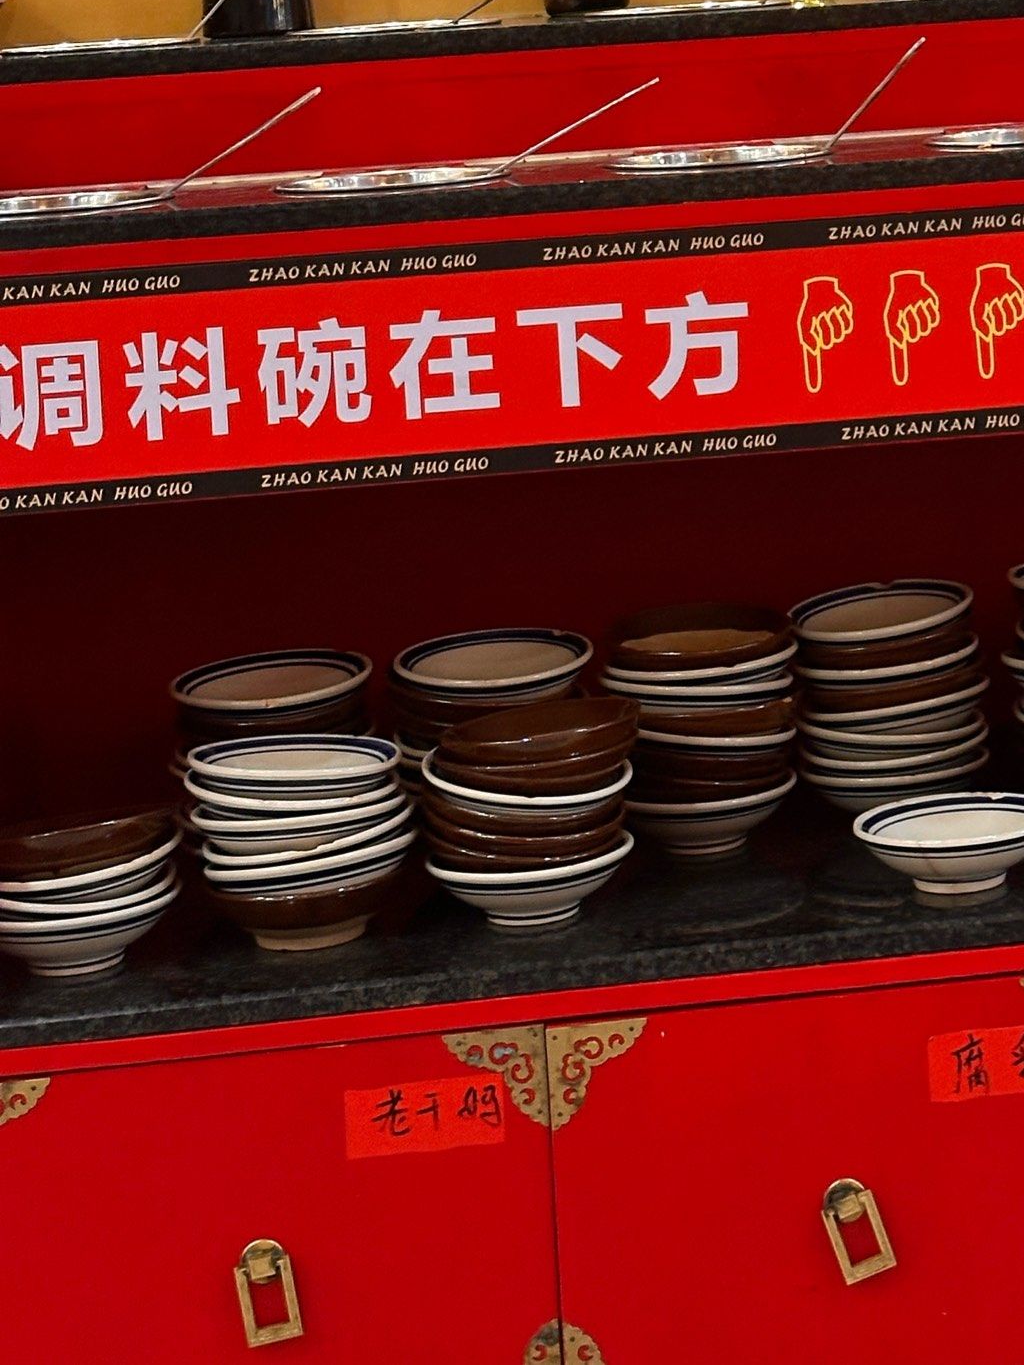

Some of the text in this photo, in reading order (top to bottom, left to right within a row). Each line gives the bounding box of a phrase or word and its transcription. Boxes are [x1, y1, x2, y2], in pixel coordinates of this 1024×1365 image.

[828, 224, 877, 240] ZHAO
[881, 221, 919, 236] KAN
[924, 217, 962, 233] KAN
[971, 214, 1007, 229] HUO
[543, 232, 764, 261] ZHAO KAN KAN HUO GUO
[249, 253, 477, 283] ZHAO KAN KAN HUO GUO
[2, 274, 181, 301] KAN KAN HUO GUO
[0, 291, 749, 451] 调料碗在下方
[841, 424, 890, 441] ZHAO
[894, 420, 933, 436] KAN
[937, 417, 976, 433] KAN
[985, 413, 1020, 429] HUO
[554, 433, 777, 464] ZHAO KAN KAN HUO GUO
[261, 456, 489, 488] ZHAO KAN KAN HUO GUO
[15, 492, 57, 509] KAN
[62, 488, 104, 505] KAN
[114, 485, 152, 501] HUO
[156, 481, 193, 498] GUO
[371, 1084, 503, 1137] 老干妈
